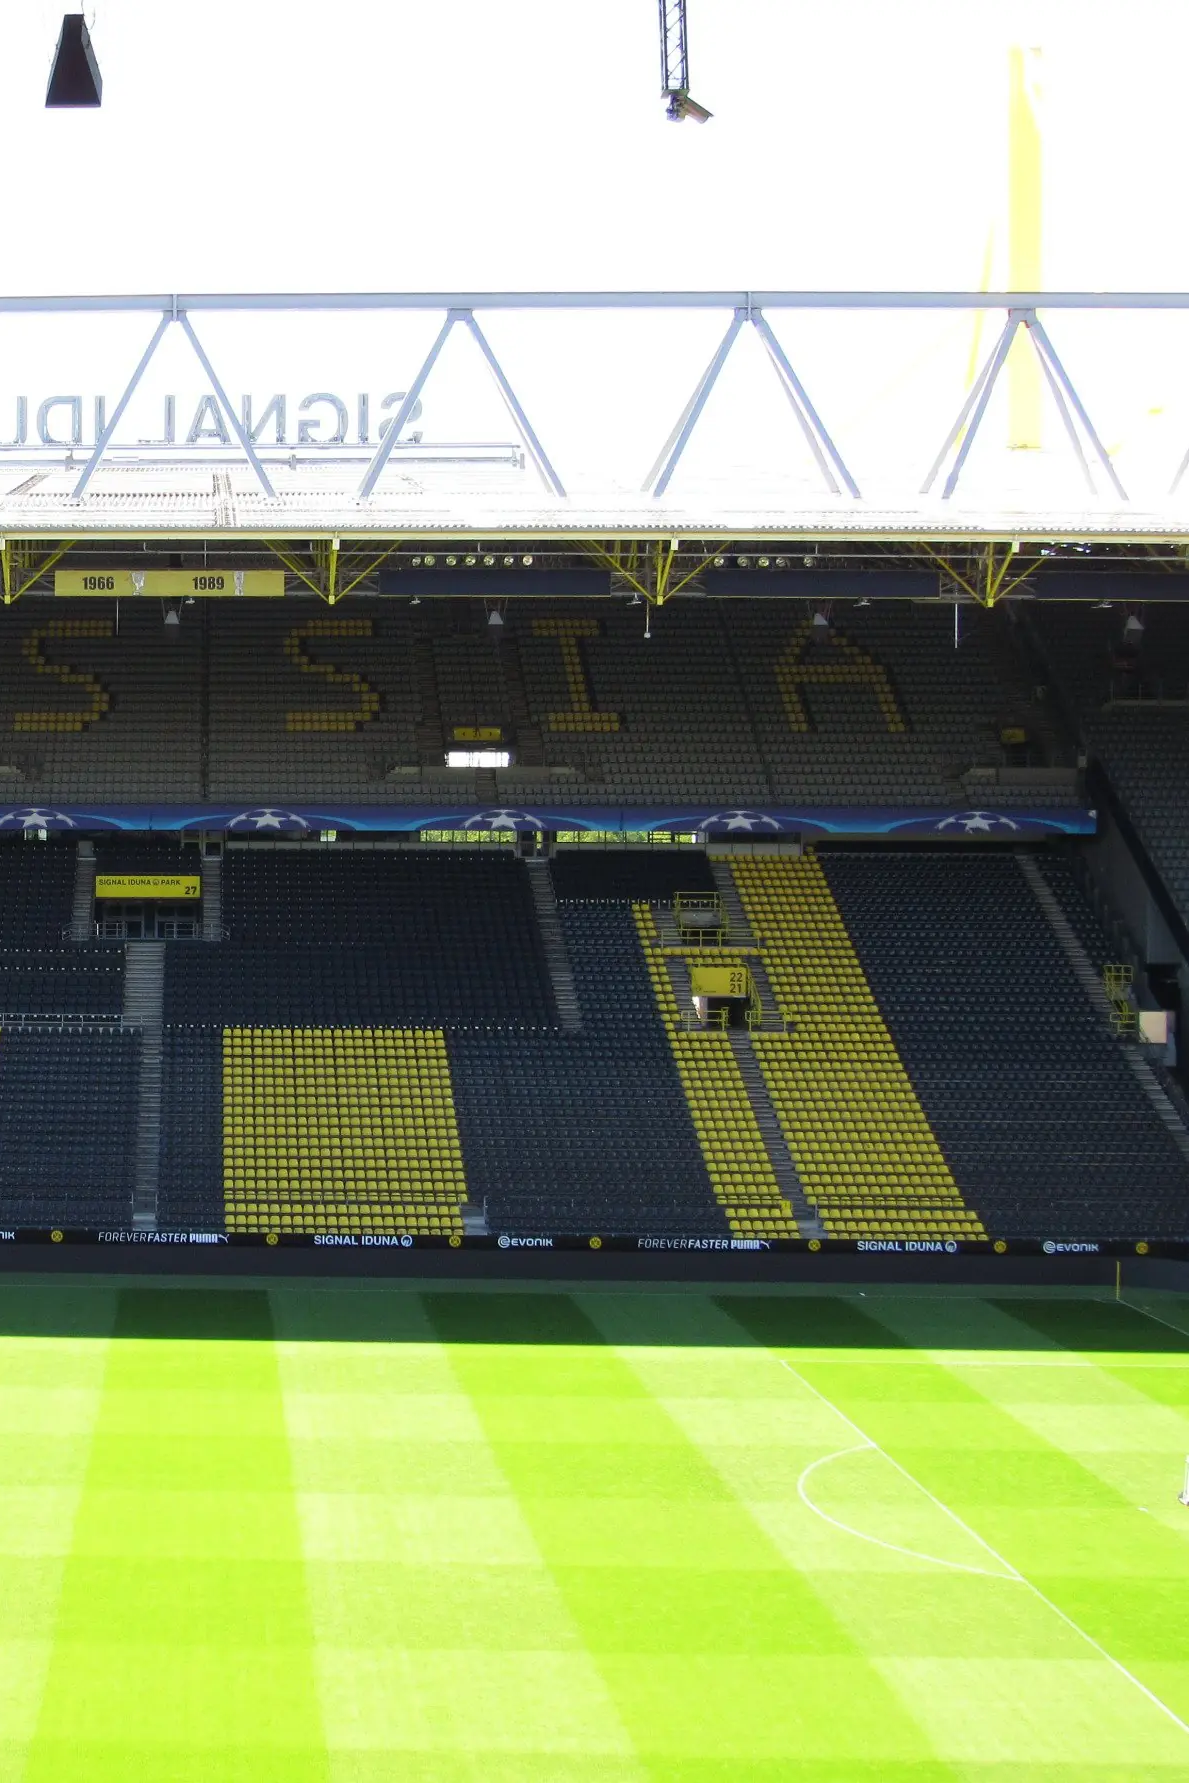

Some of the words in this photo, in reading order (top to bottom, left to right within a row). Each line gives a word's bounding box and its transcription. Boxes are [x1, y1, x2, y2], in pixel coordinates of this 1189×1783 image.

[82, 576, 115, 591] 1966
[192, 576, 225, 591] 1989
[99, 878, 127, 886] SIGNAL
[128, 878, 152, 886] IDUNA
[184, 886, 197, 895] 27
[729, 972, 743, 982] 22
[729, 983, 742, 993] 21
[189, 1233, 218, 1244] PUMA
[313, 1234, 359, 1245] SIGNAL
[361, 1235, 399, 1245] IDUNA
[730, 1239, 760, 1250] PUMA
[857, 1240, 902, 1251] SIGNAL
[905, 1240, 943, 1251] IDUNA
